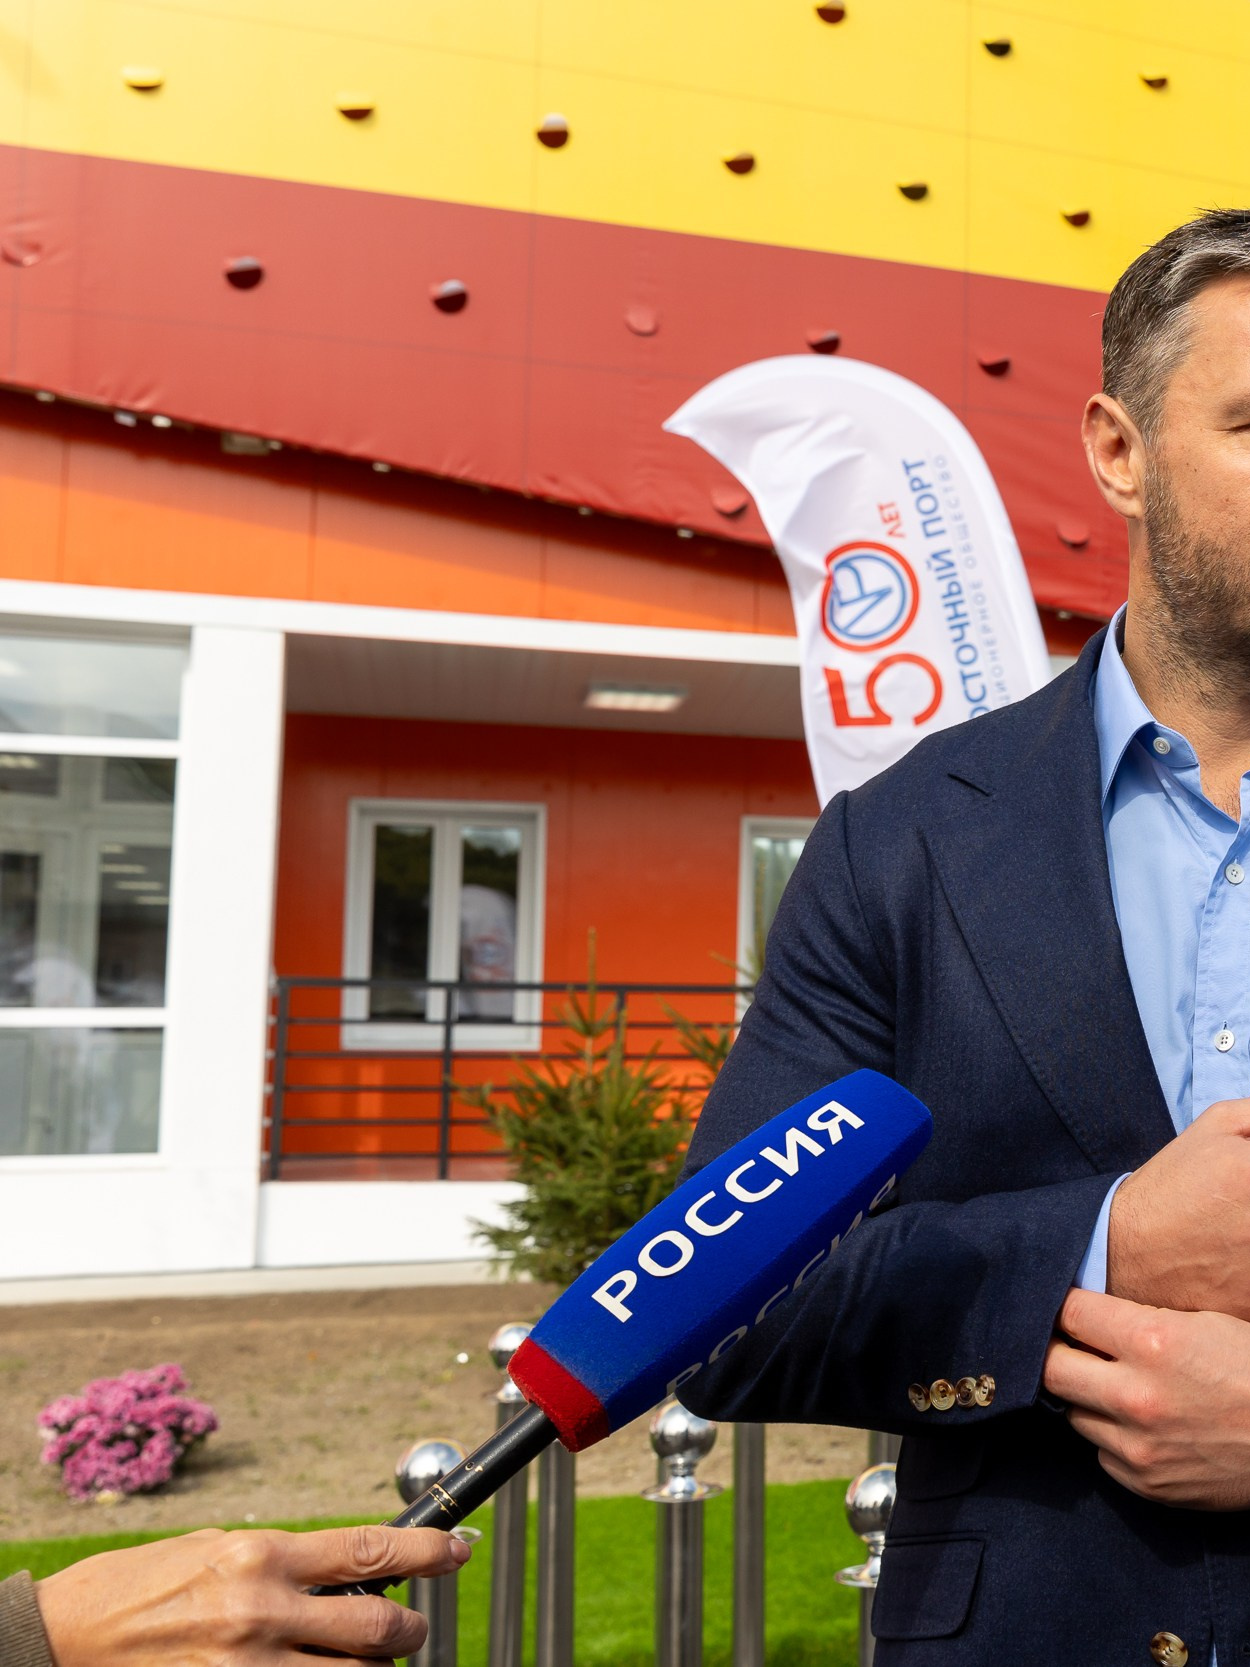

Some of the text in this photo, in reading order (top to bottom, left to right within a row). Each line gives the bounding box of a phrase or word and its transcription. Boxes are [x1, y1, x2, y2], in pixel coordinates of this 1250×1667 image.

[902, 458, 946, 539] ПОРТ
[820, 500, 943, 729] 50 ЛЕТ
[590, 1099, 866, 1324] РОССИЯ
